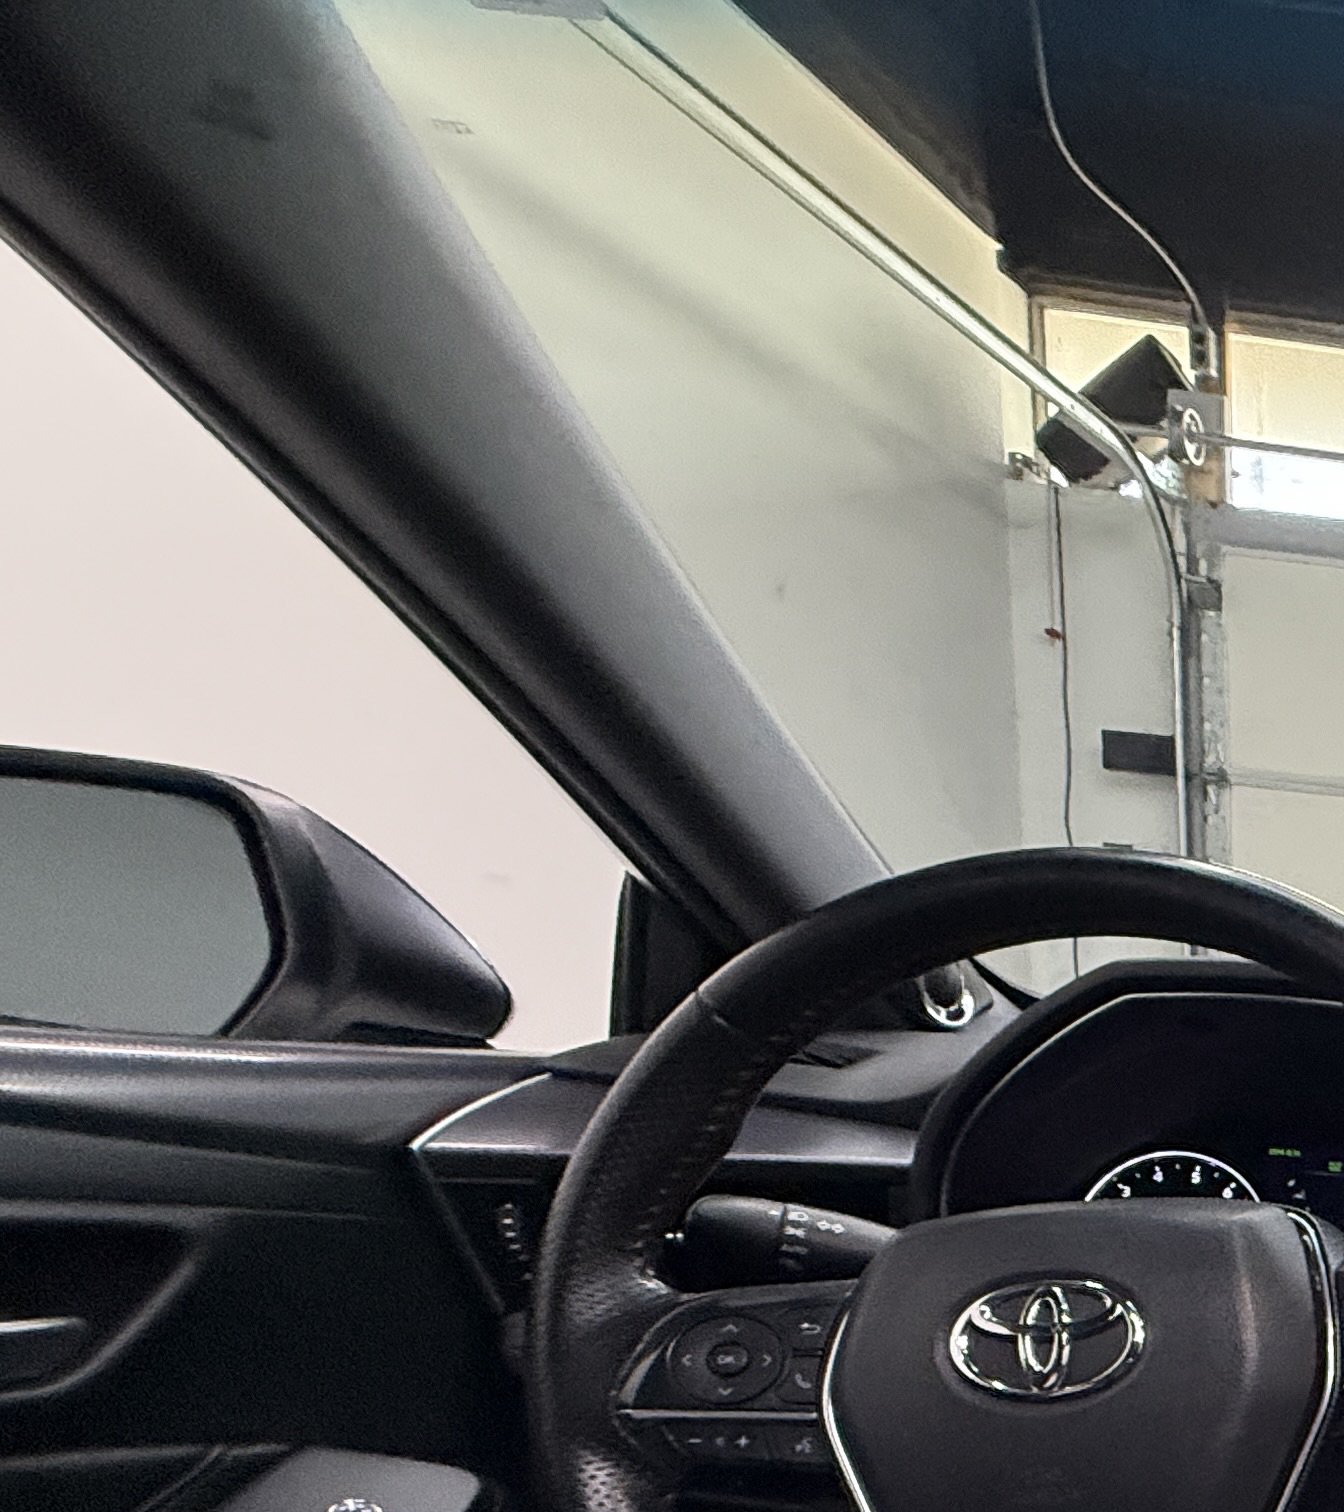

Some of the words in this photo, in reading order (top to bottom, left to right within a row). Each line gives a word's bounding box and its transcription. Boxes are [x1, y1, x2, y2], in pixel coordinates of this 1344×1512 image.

[1152, 1171, 1164, 1183] 4
[1190, 1171, 1202, 1184] 5
[1221, 1186, 1234, 1199] 6
